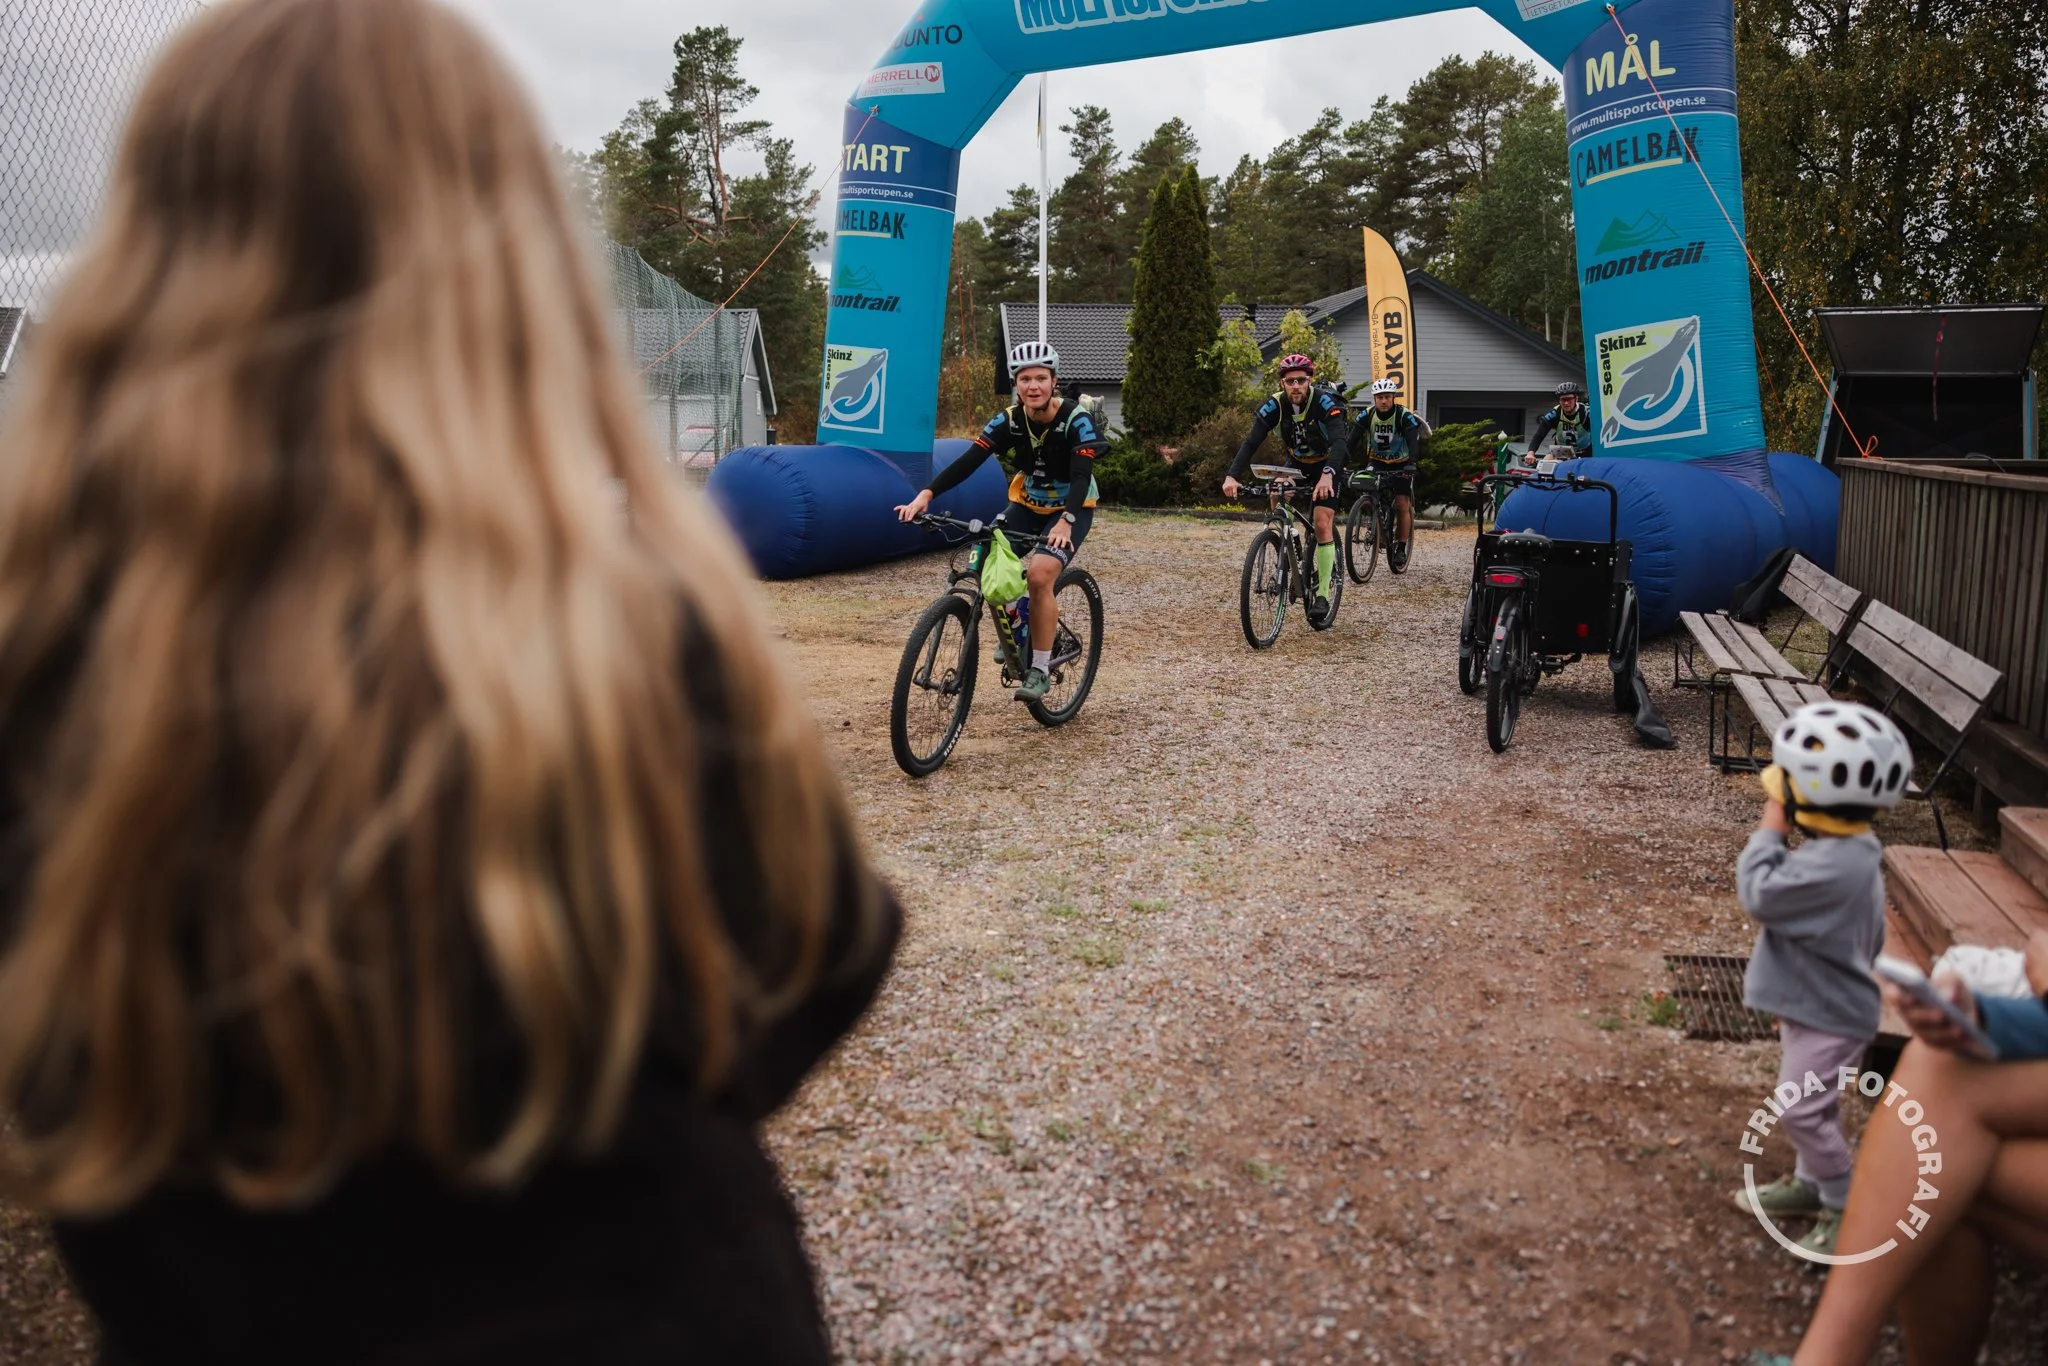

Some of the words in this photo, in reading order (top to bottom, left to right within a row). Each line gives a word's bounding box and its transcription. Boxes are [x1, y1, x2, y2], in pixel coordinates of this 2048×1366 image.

[1586, 34, 1676, 96] MÅL
[1571, 95, 1706, 136] www.multisportcupen.se
[840, 143, 911, 174] TART
[1576, 127, 1702, 189] CAMELBAK
[1584, 241, 1706, 286] montrail
[1600, 332, 1647, 353] Skinz
[1600, 351, 1613, 396] Seal
[1073, 416, 1097, 443] 2
